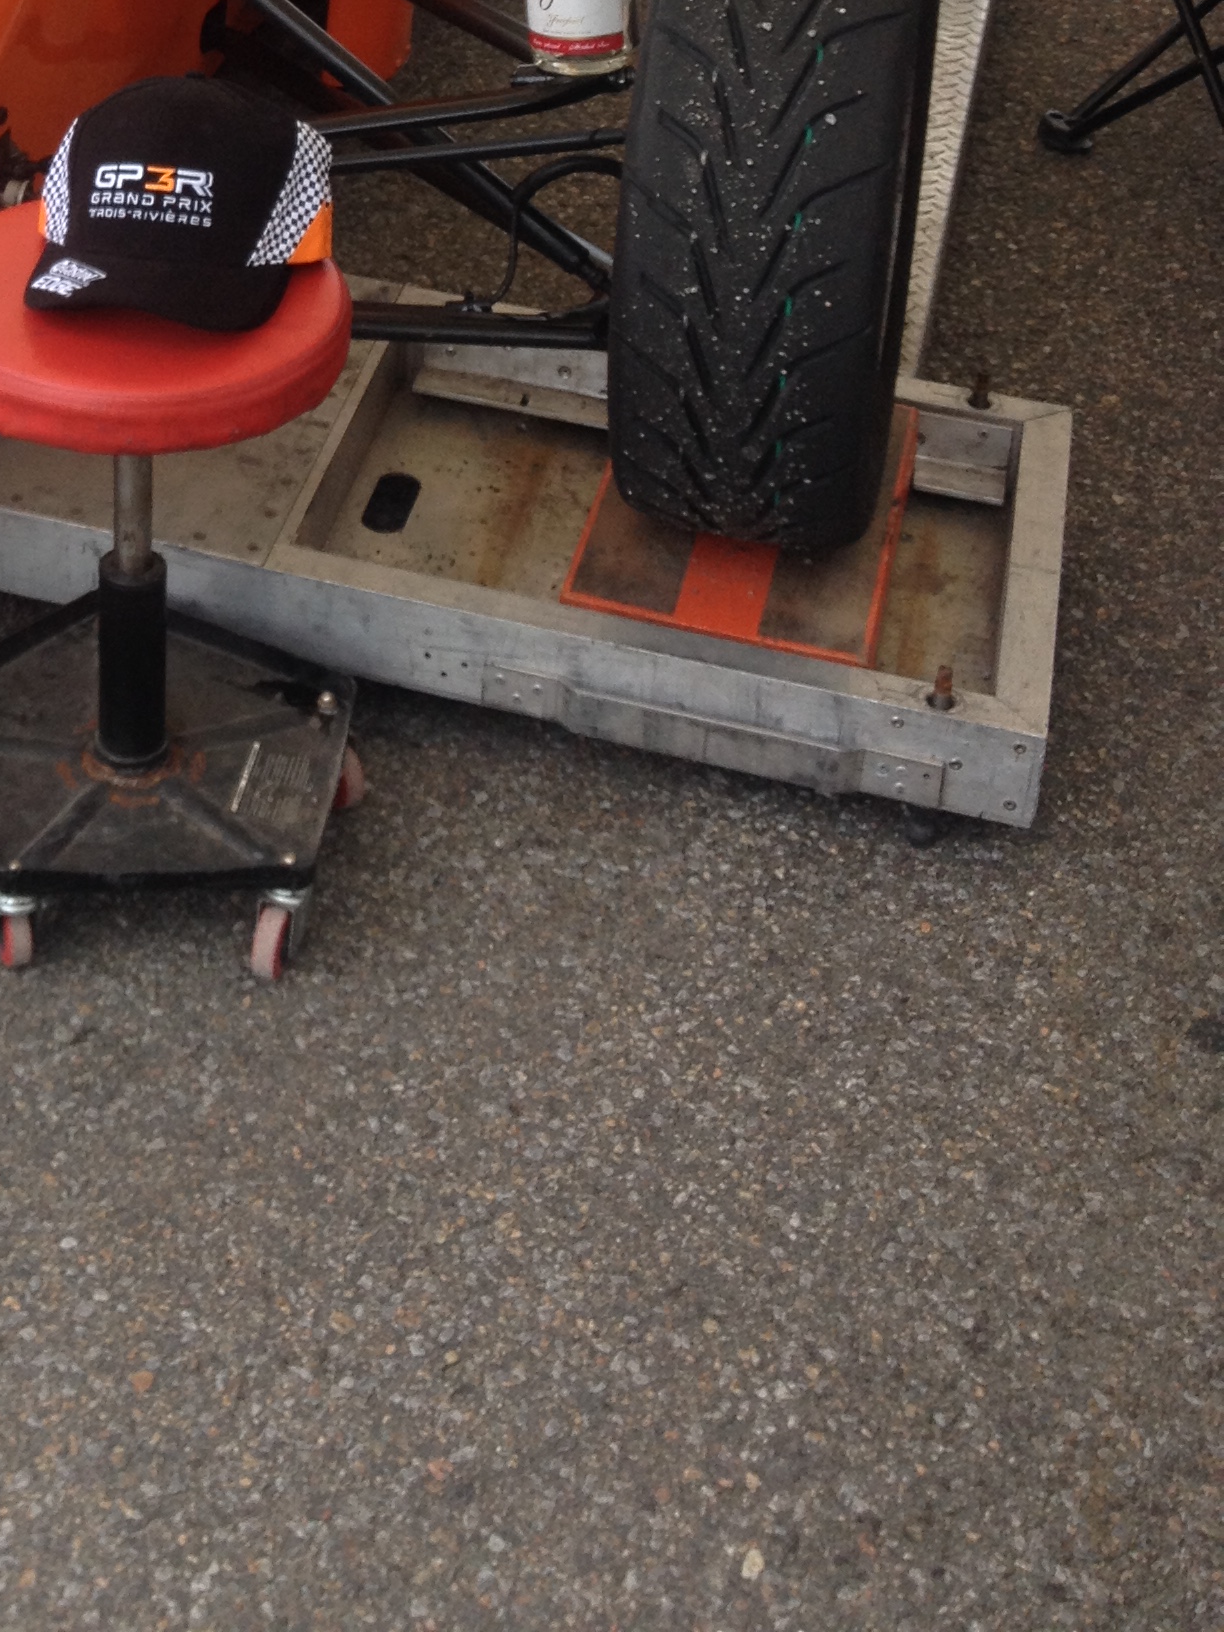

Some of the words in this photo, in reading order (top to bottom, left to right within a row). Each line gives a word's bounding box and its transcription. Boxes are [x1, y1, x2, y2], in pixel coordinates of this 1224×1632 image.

[95, 164, 213, 197] GP3R
[90, 191, 155, 206] GRAND
[162, 196, 213, 213] PRIX
